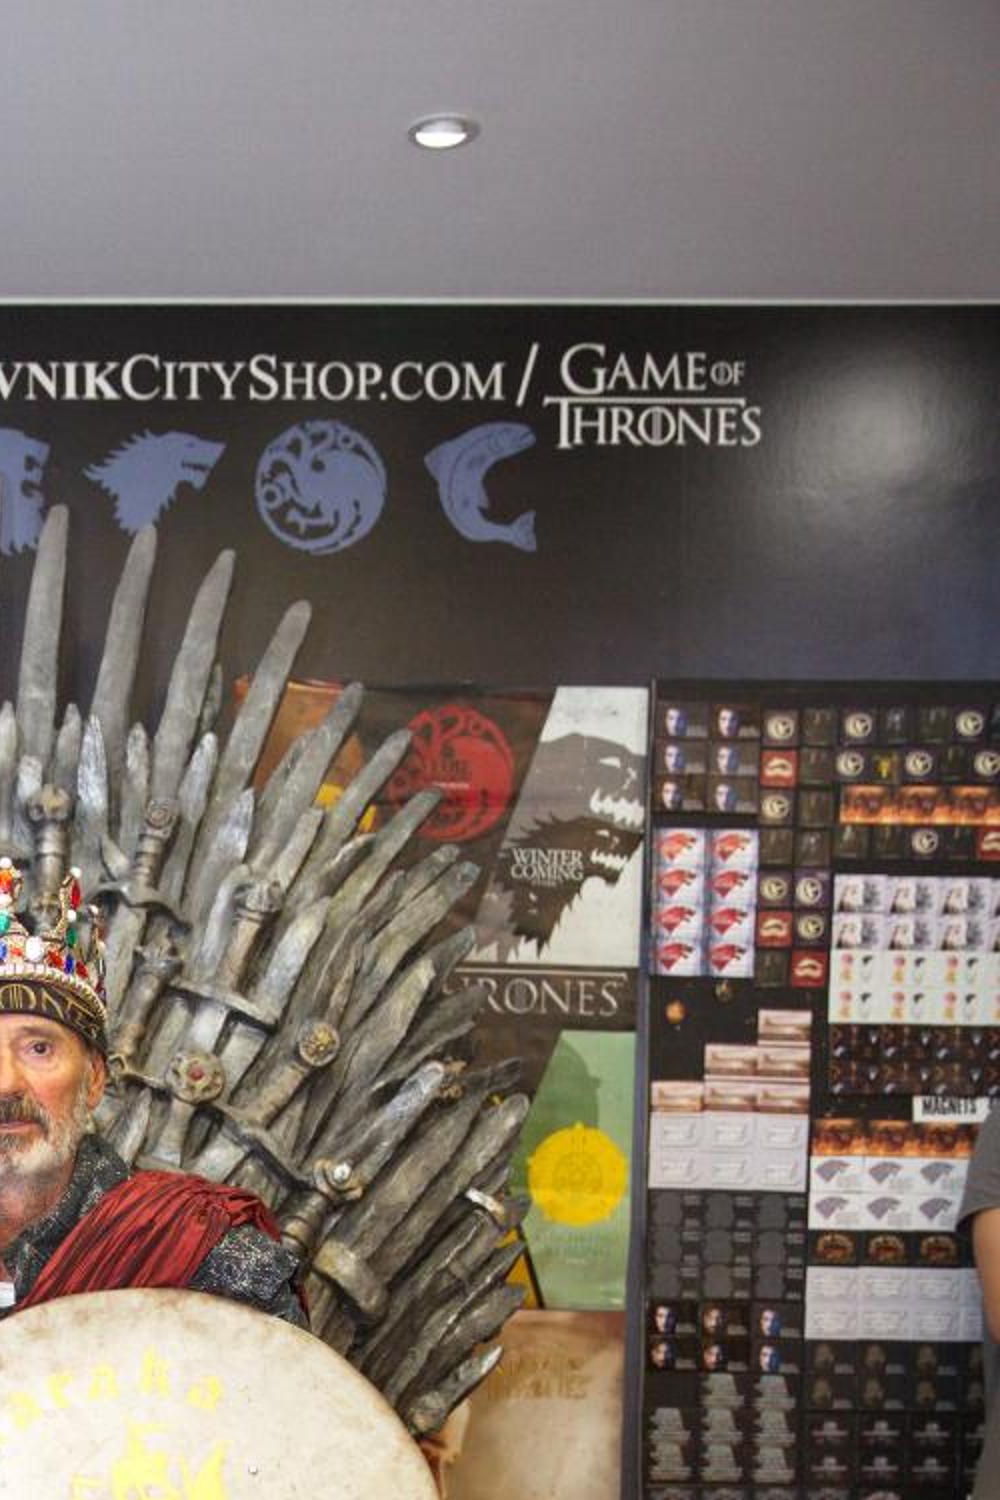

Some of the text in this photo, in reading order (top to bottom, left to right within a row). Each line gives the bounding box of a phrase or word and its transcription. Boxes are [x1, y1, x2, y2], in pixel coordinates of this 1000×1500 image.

[559, 342, 708, 396] GAME
[709, 361, 746, 388] OF
[543, 396, 762, 449] THRONES
[510, 863, 584, 881] COMING
[511, 848, 583, 865] WINTER
